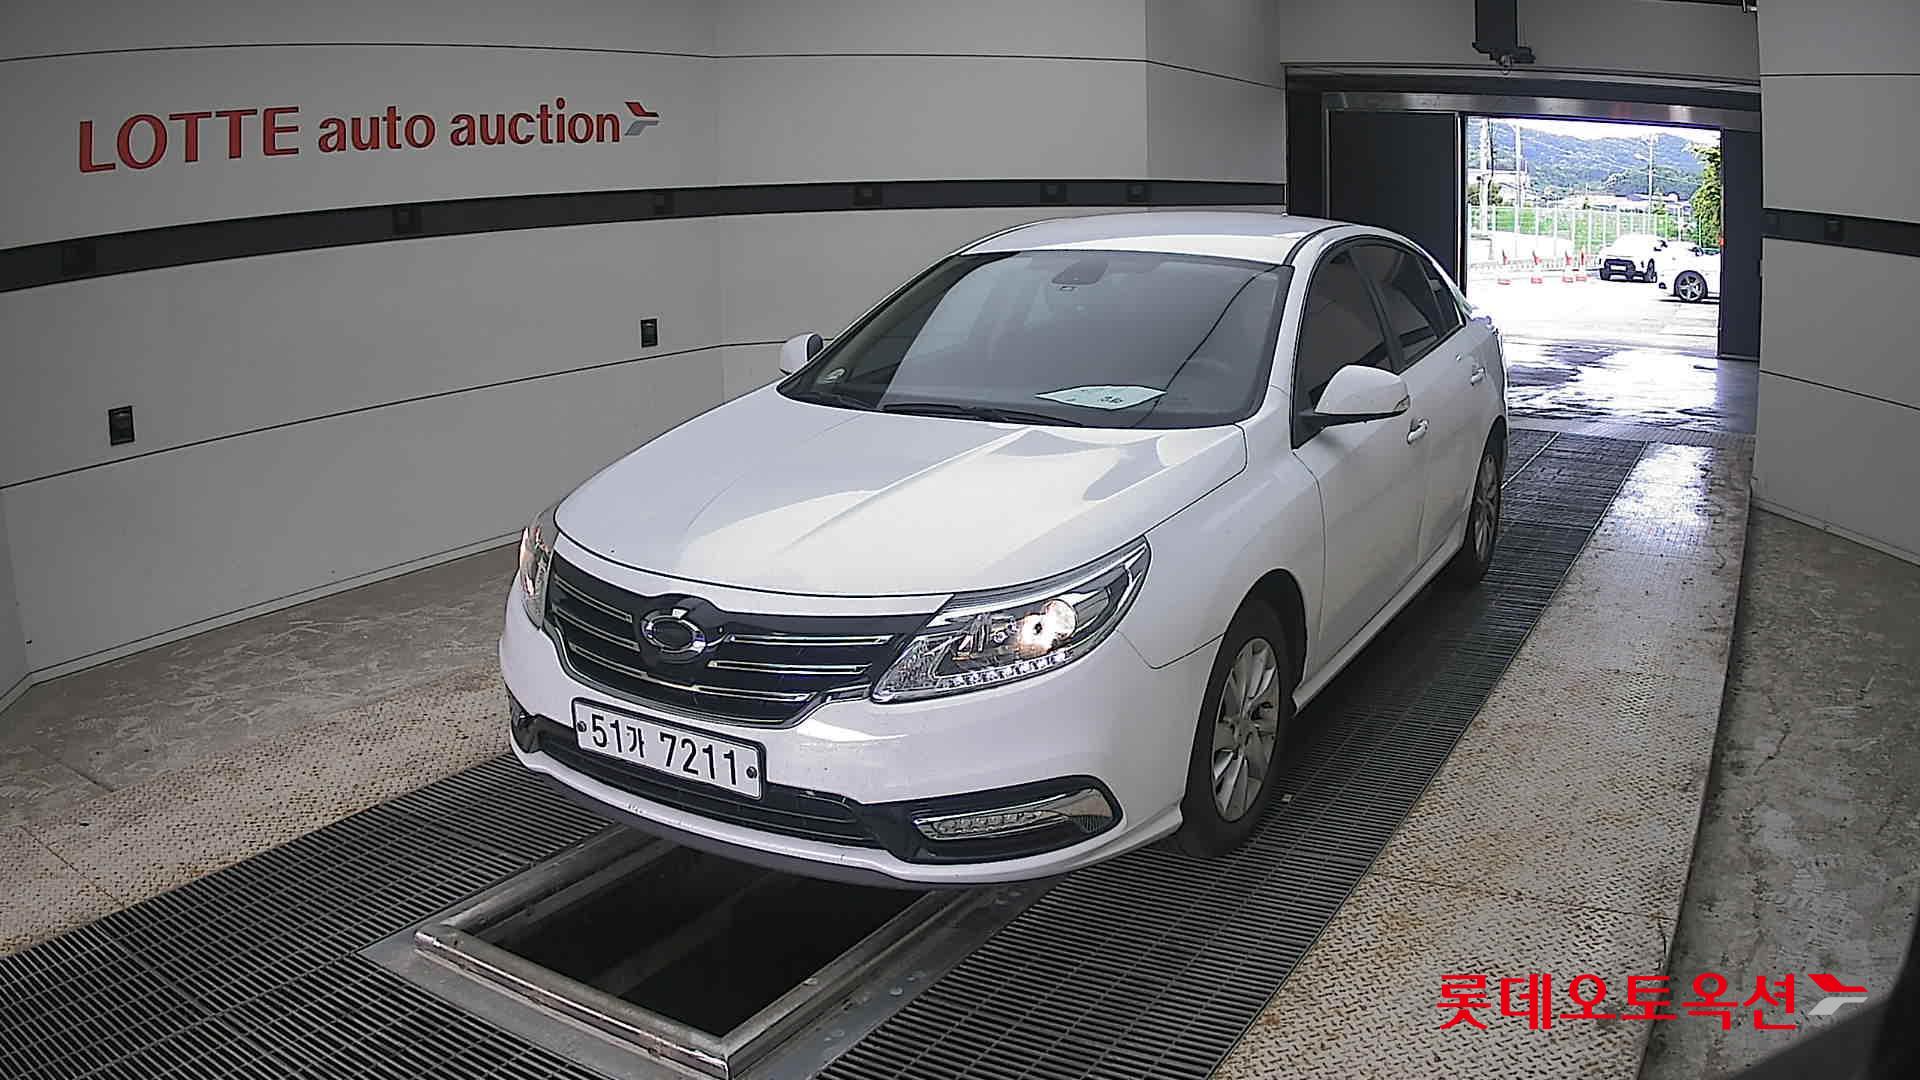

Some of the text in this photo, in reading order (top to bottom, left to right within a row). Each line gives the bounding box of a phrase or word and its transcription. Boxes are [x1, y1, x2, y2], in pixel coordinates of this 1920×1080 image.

[79, 97, 621, 173] LOTTE auto auction
[591, 713, 737, 786] 51가 7211
